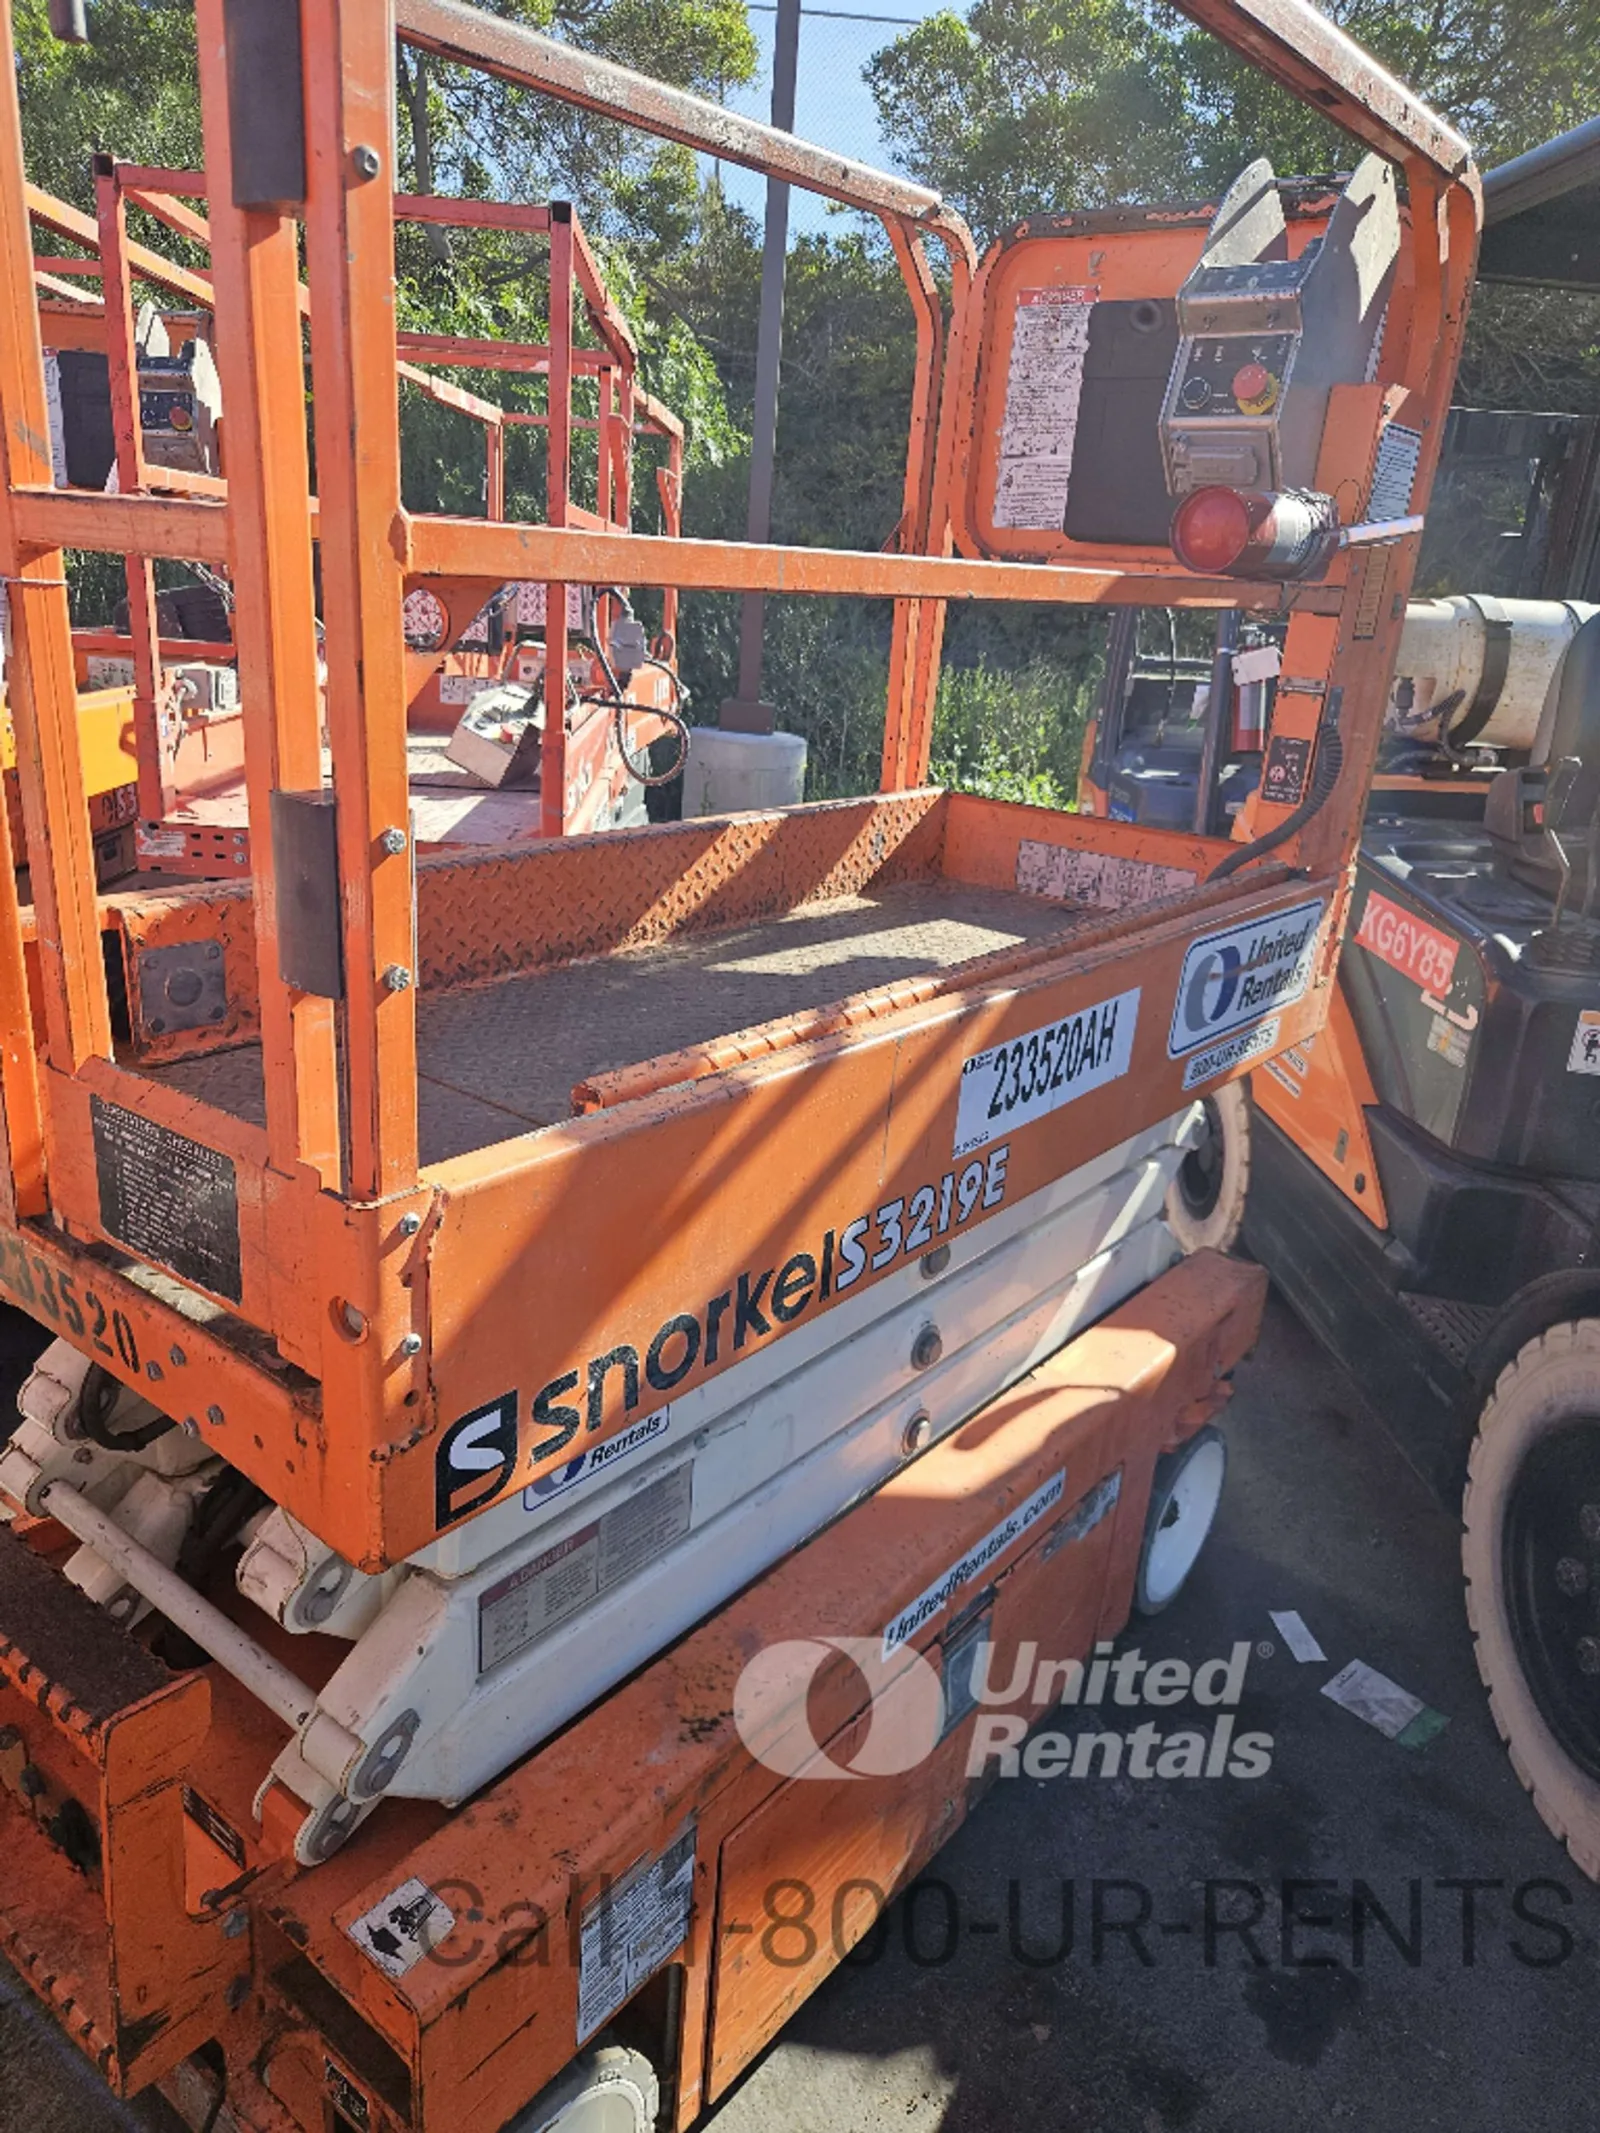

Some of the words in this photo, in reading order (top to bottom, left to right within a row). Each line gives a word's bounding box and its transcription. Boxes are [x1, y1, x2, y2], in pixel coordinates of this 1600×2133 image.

[1236, 957, 1306, 1011] Rentals
[1248, 918, 1313, 962] United
[1360, 903, 1456, 990] KG6Y85
[987, 1000, 1118, 1119] 233520AH
[836, 1144, 1010, 1292] S3219E
[530, 1228, 835, 1464] snorkel
[589, 1416, 662, 1469] Rentals
[883, 1480, 1063, 1653] UnitedRentals.com
